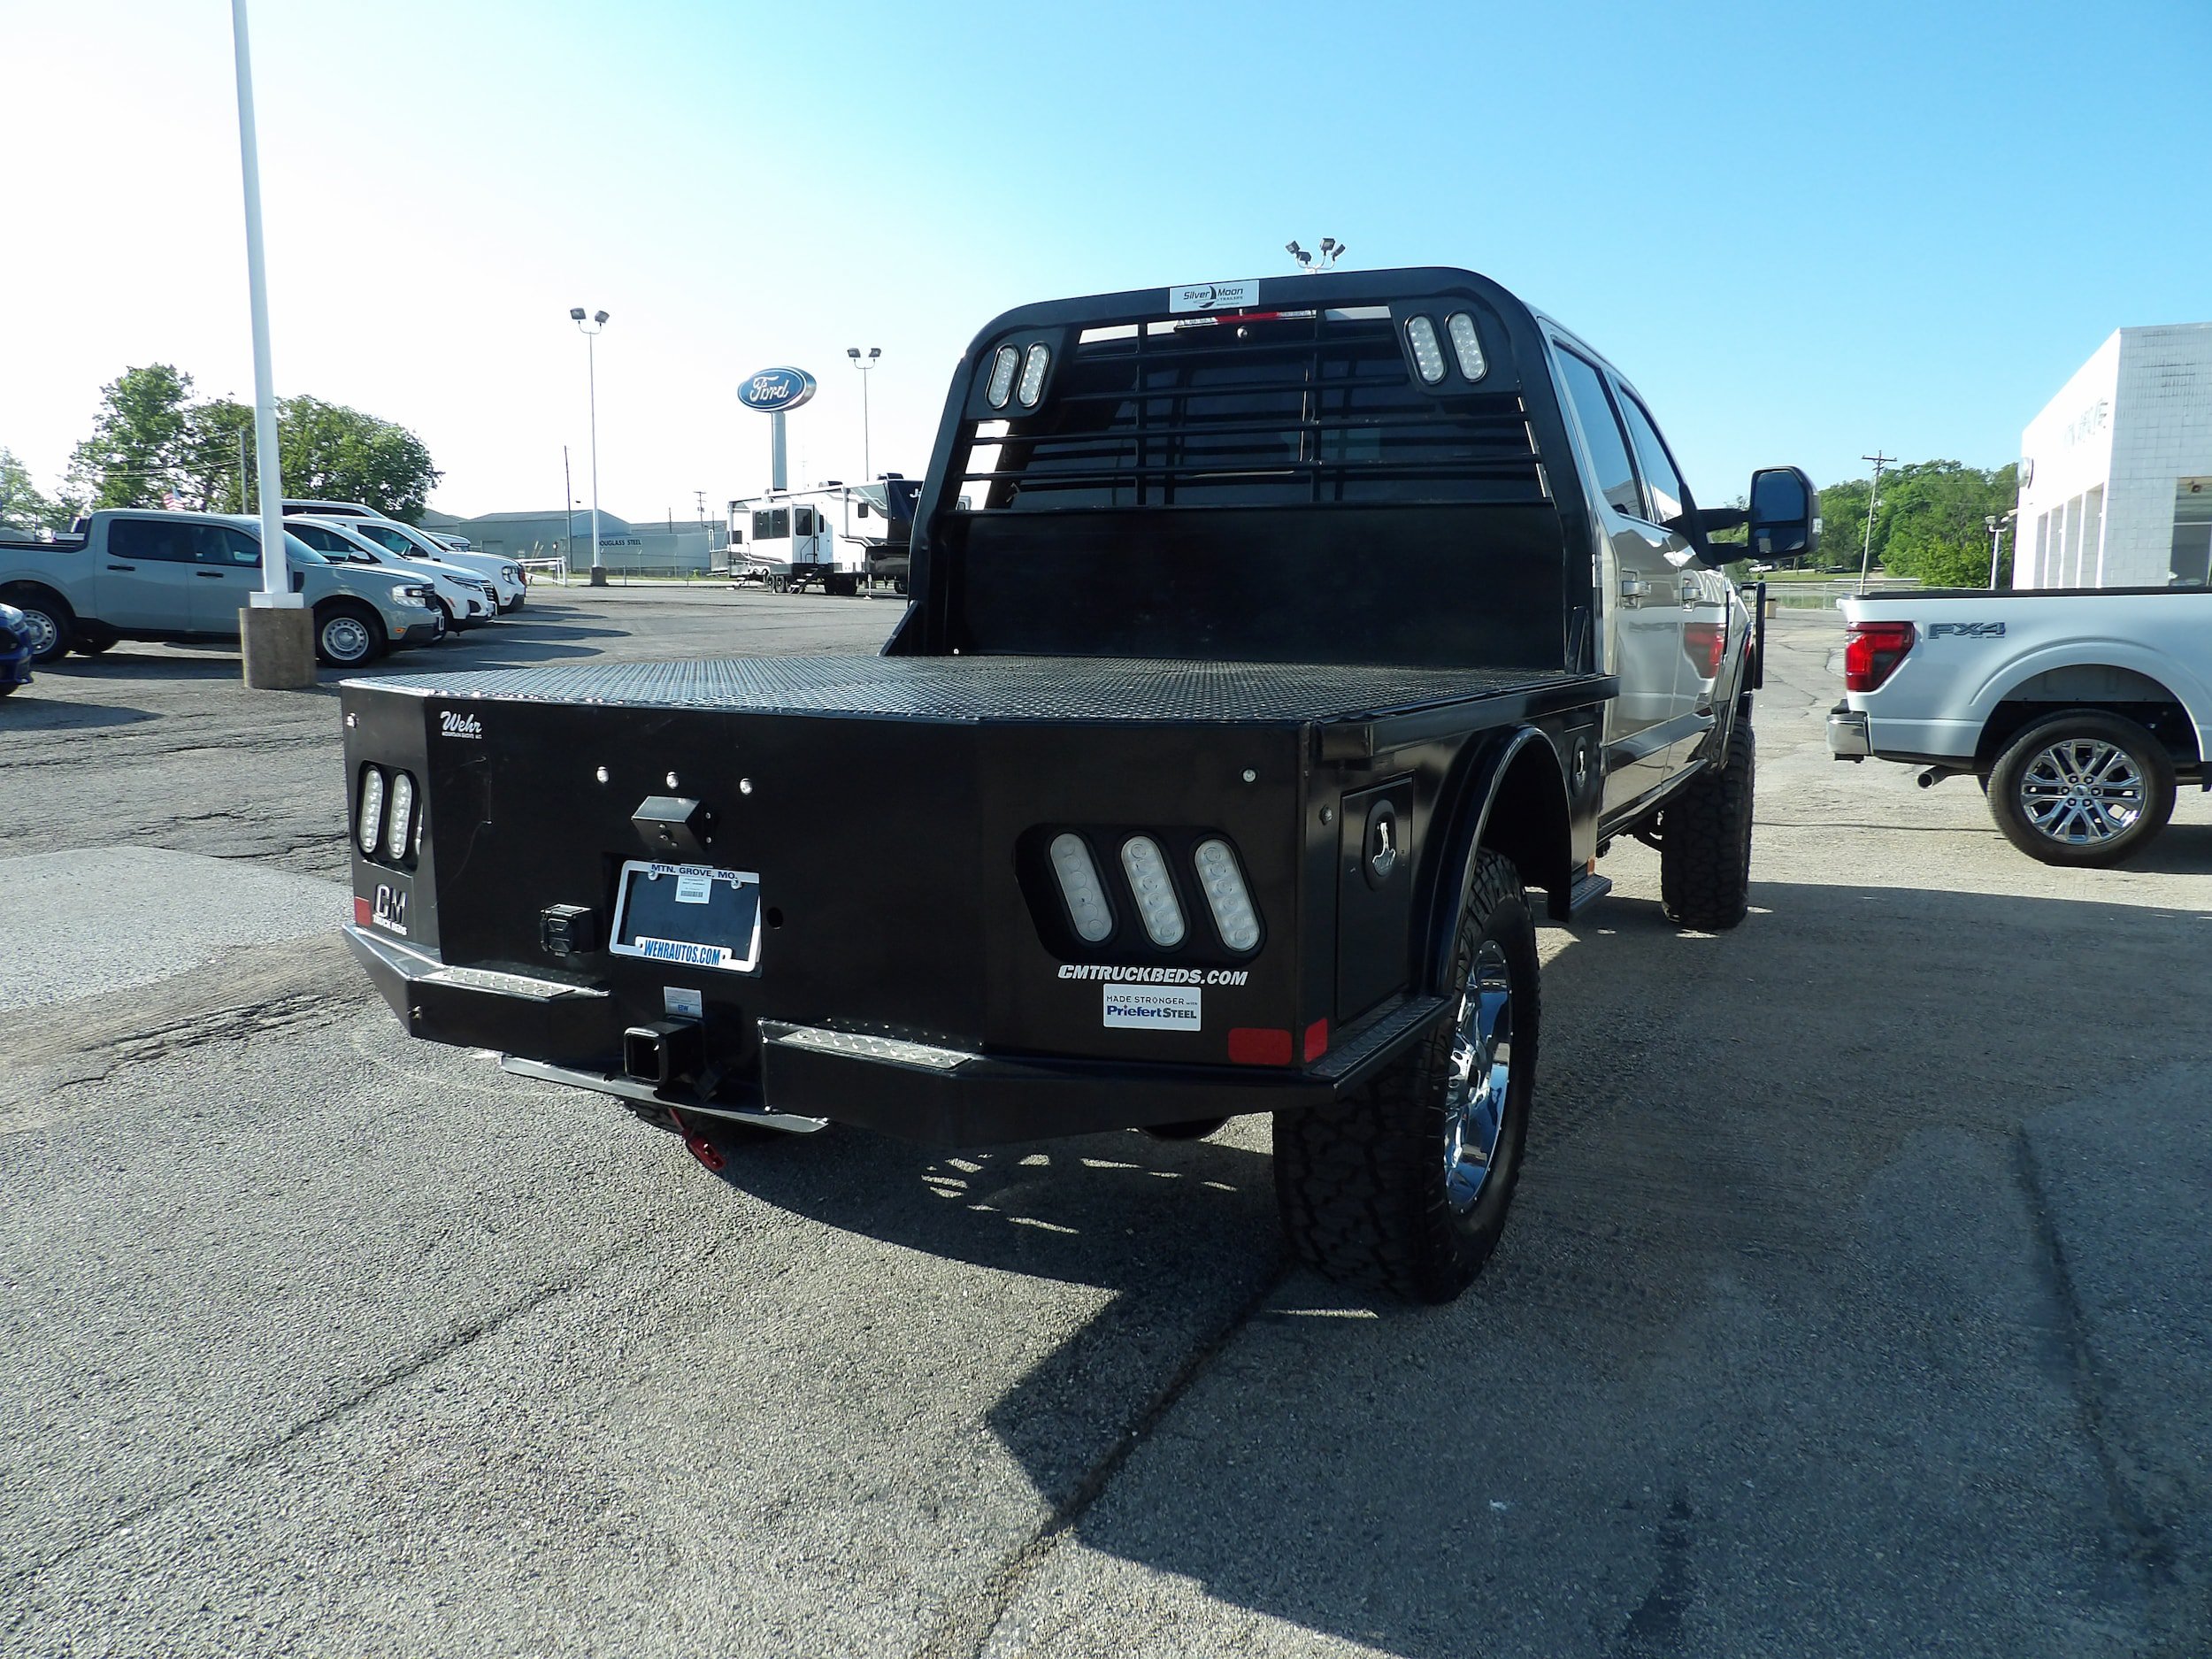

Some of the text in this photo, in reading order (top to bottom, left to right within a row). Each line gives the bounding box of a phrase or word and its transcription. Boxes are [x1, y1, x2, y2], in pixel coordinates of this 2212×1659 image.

[1184, 291, 1210, 300] Silver
[749, 375, 789, 403] Ford
[1928, 622, 2005, 639] FX4
[440, 710, 483, 733] Wehr
[651, 864, 738, 879] MTN. GROVE, MO.
[644, 939, 721, 965] WEHRAUTOS.COM
[1057, 964, 1248, 986] CMTRUCKBEDS.COM
[1134, 996, 1185, 1005] STRONGER
